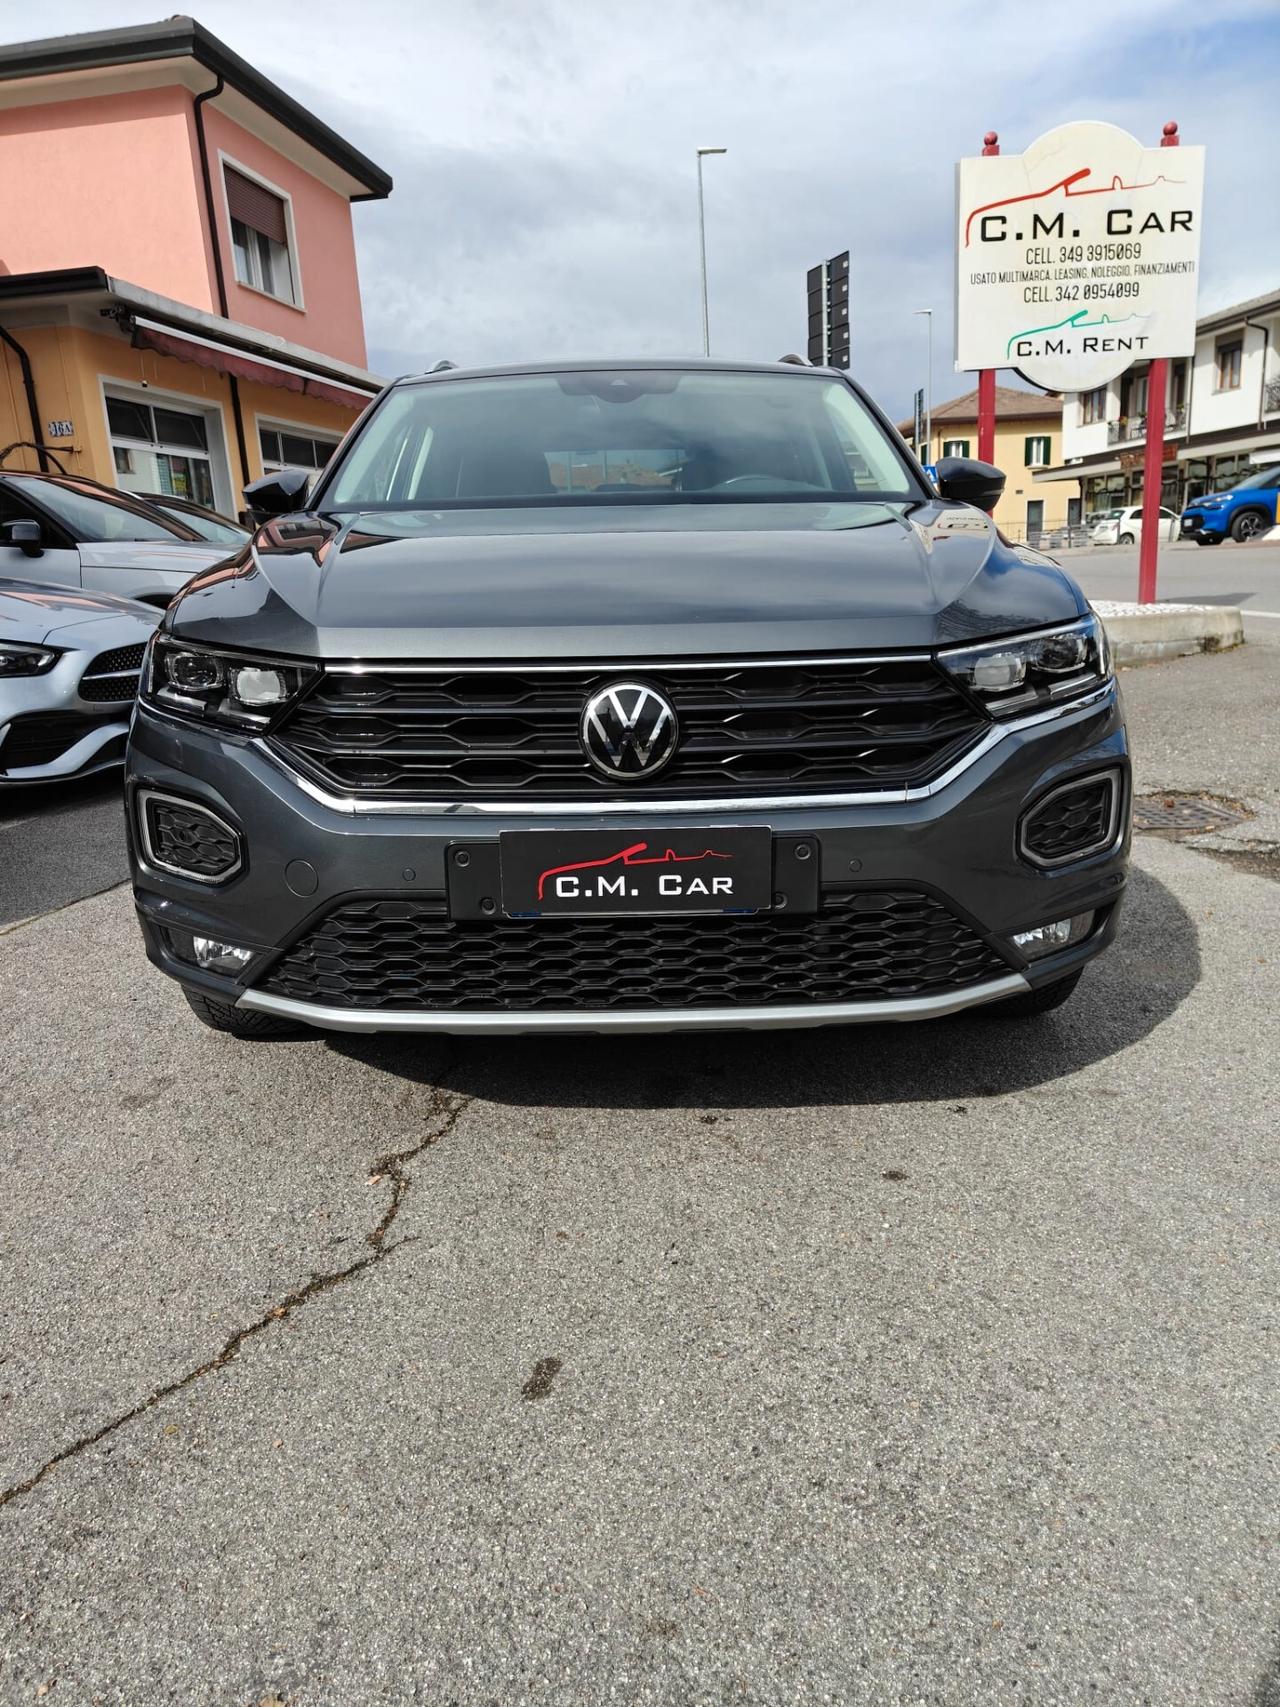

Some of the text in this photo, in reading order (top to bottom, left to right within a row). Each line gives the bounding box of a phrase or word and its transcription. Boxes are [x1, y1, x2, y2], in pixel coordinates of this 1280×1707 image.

[980, 212, 1080, 242] C.M.
[1026, 242, 1142, 265] CELL. 349 3915069
[970, 271, 997, 285] USATO
[1134, 261, 1195, 276] FINANZIAMENTI
[1023, 281, 1140, 303] CELL. 342 0954099
[1017, 339, 1071, 357] C.M.
[556, 875, 639, 897] C.M.
